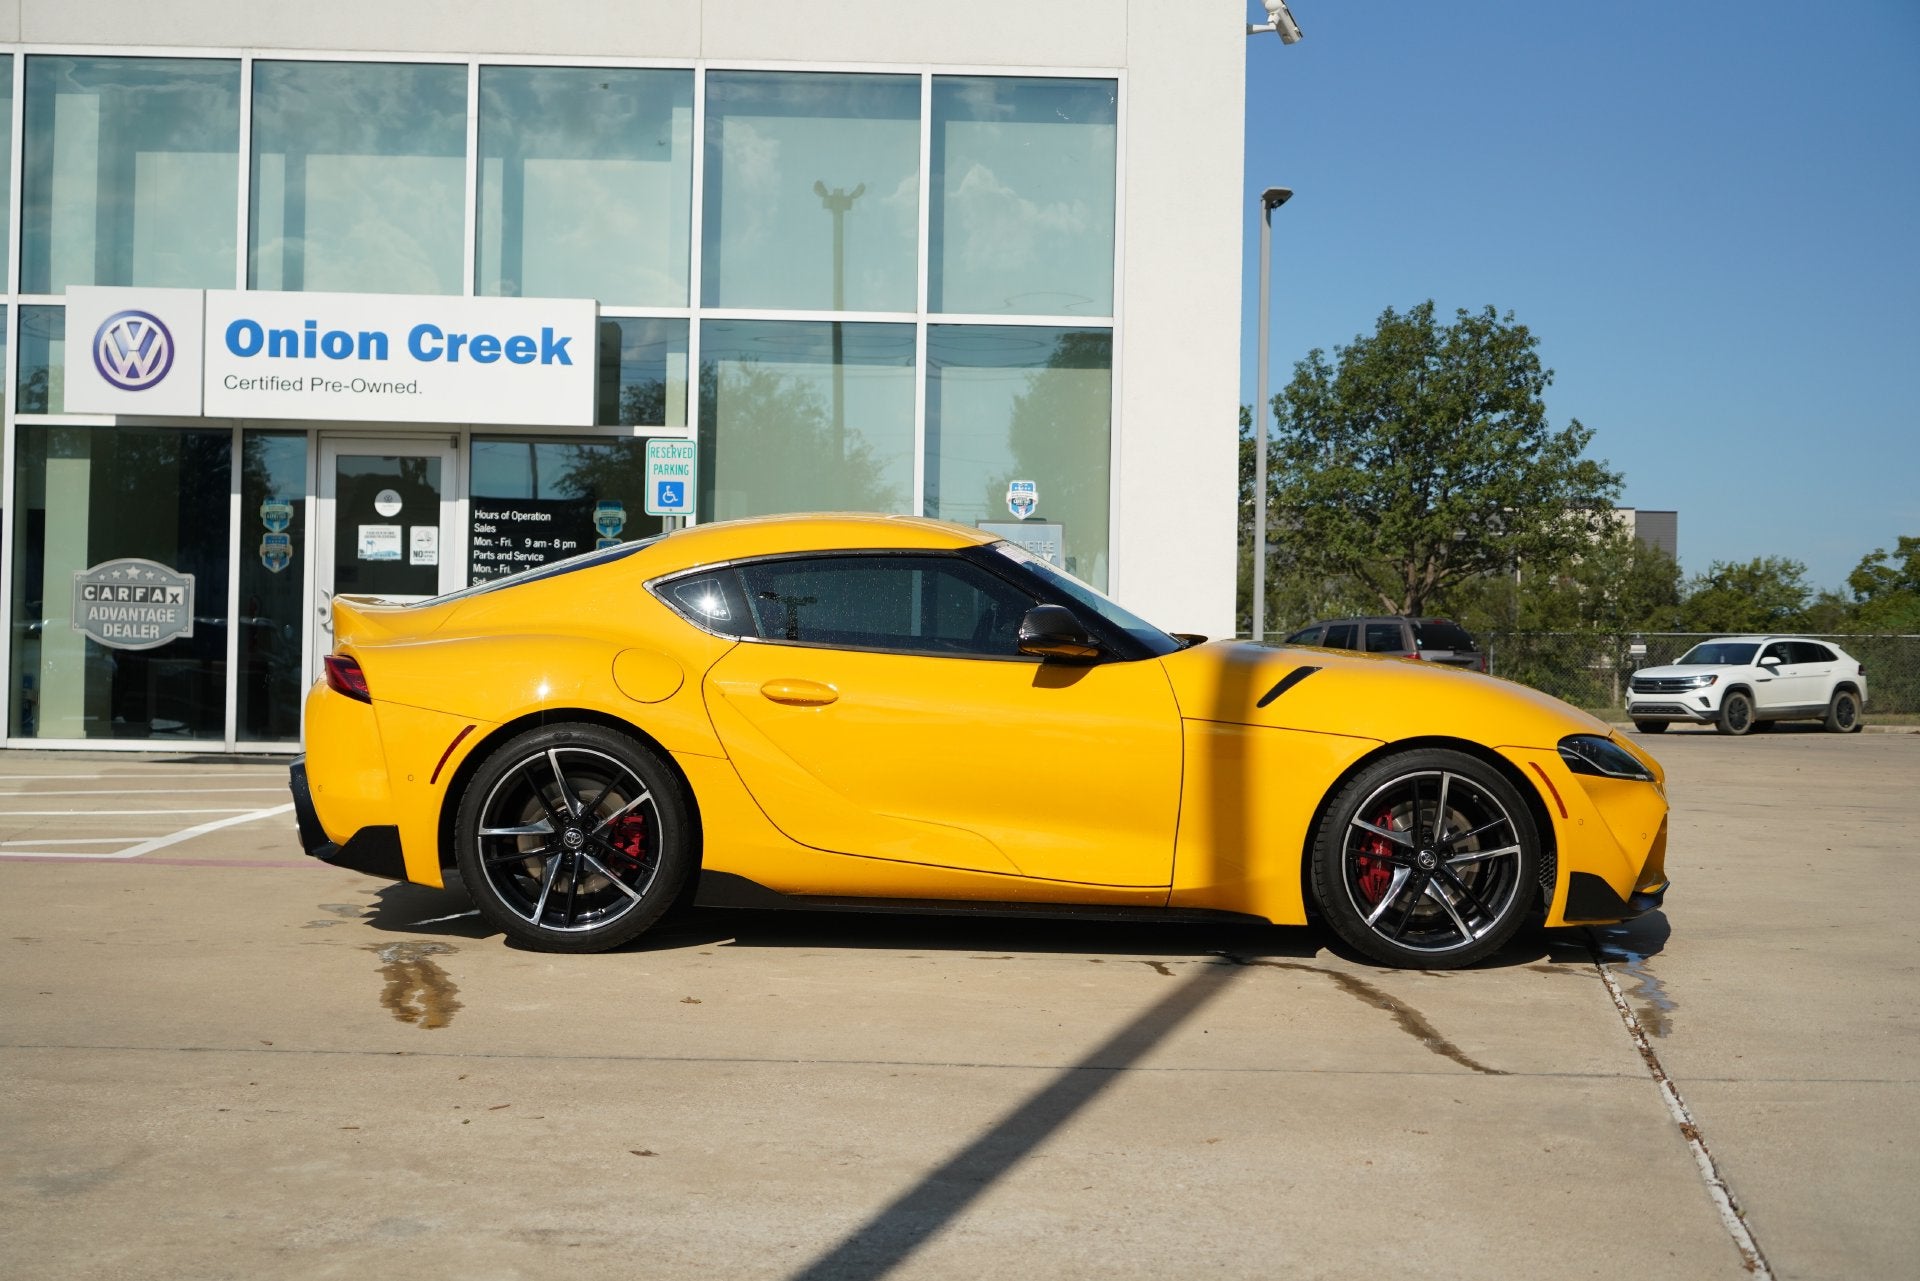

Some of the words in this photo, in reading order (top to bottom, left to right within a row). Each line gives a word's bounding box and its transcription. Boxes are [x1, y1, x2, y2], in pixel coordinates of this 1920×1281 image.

[225, 319, 389, 361] Onion
[408, 323, 573, 366] Creek
[223, 374, 304, 392] Certified
[310, 377, 423, 395] Pre-Owned.
[650, 447, 693, 459] RESERVED
[653, 464, 689, 476] PARKING
[474, 509, 500, 520] Hours
[500, 511, 510, 520] of
[511, 511, 552, 522] Operation
[473, 523, 497, 533] Sales
[473, 536, 494, 546] Mon.
[500, 537, 512, 547] Fri.
[524, 538, 532, 548] 9
[532, 540, 547, 548] am
[553, 538, 561, 549] 8
[562, 541, 577, 551] pm
[473, 549, 496, 560] Parts
[496, 551, 512, 560] and
[514, 551, 545, 562] Service
[472, 563, 492, 574] Mon.
[499, 563, 512, 574] Fri.
[82, 585, 182, 604] CARFAX
[88, 606, 175, 623] ADVANTAGE
[103, 623, 160, 639] DEALER
